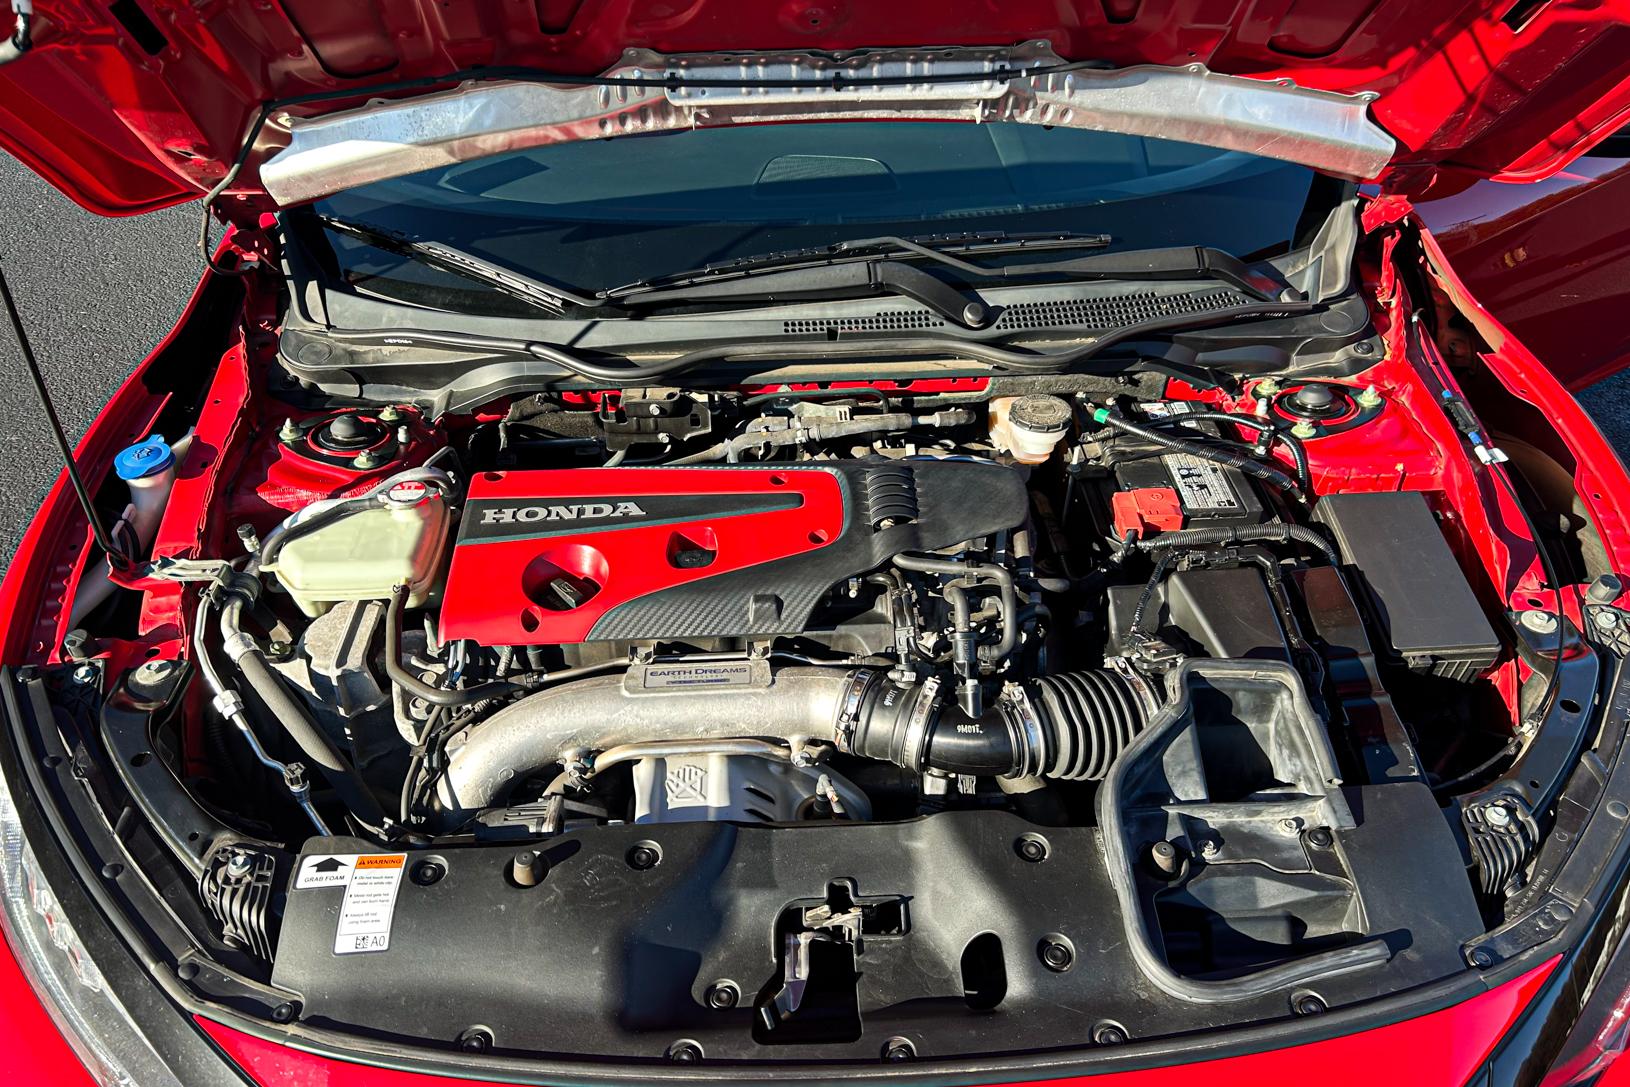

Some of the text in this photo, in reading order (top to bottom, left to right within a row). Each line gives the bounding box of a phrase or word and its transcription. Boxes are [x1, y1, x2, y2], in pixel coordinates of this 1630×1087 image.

[480, 501, 647, 524] HONDA
[649, 667, 748, 677] EARTH DREAMS
